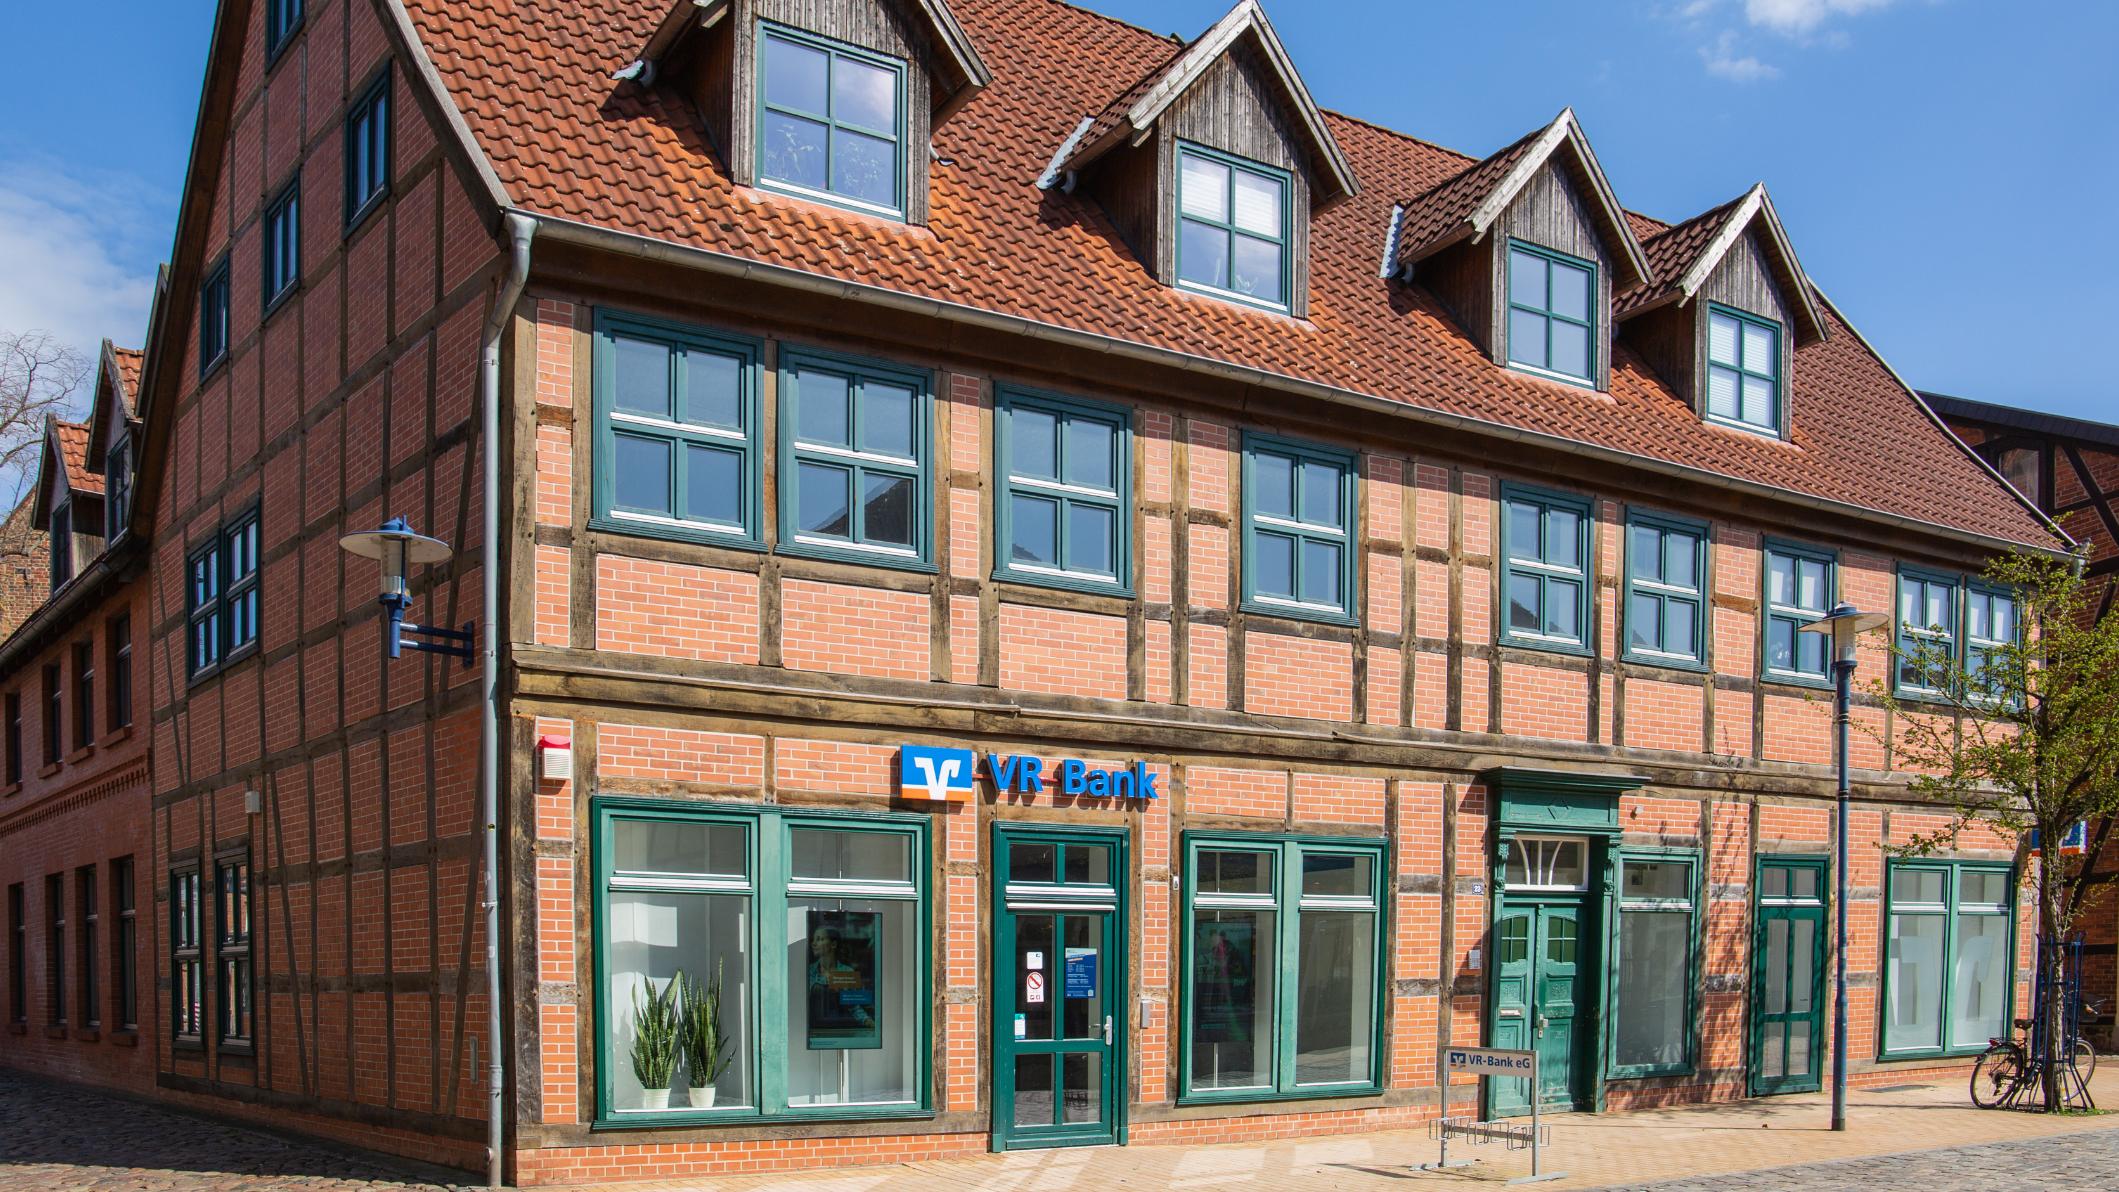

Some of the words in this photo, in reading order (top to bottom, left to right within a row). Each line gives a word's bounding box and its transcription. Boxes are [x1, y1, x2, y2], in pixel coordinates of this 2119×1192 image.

[987, 753, 1044, 793] VR
[1062, 758, 1159, 799] Bank
[1468, 1054, 1513, 1068] VR-Bank
[1516, 1058, 1530, 1069] eG
